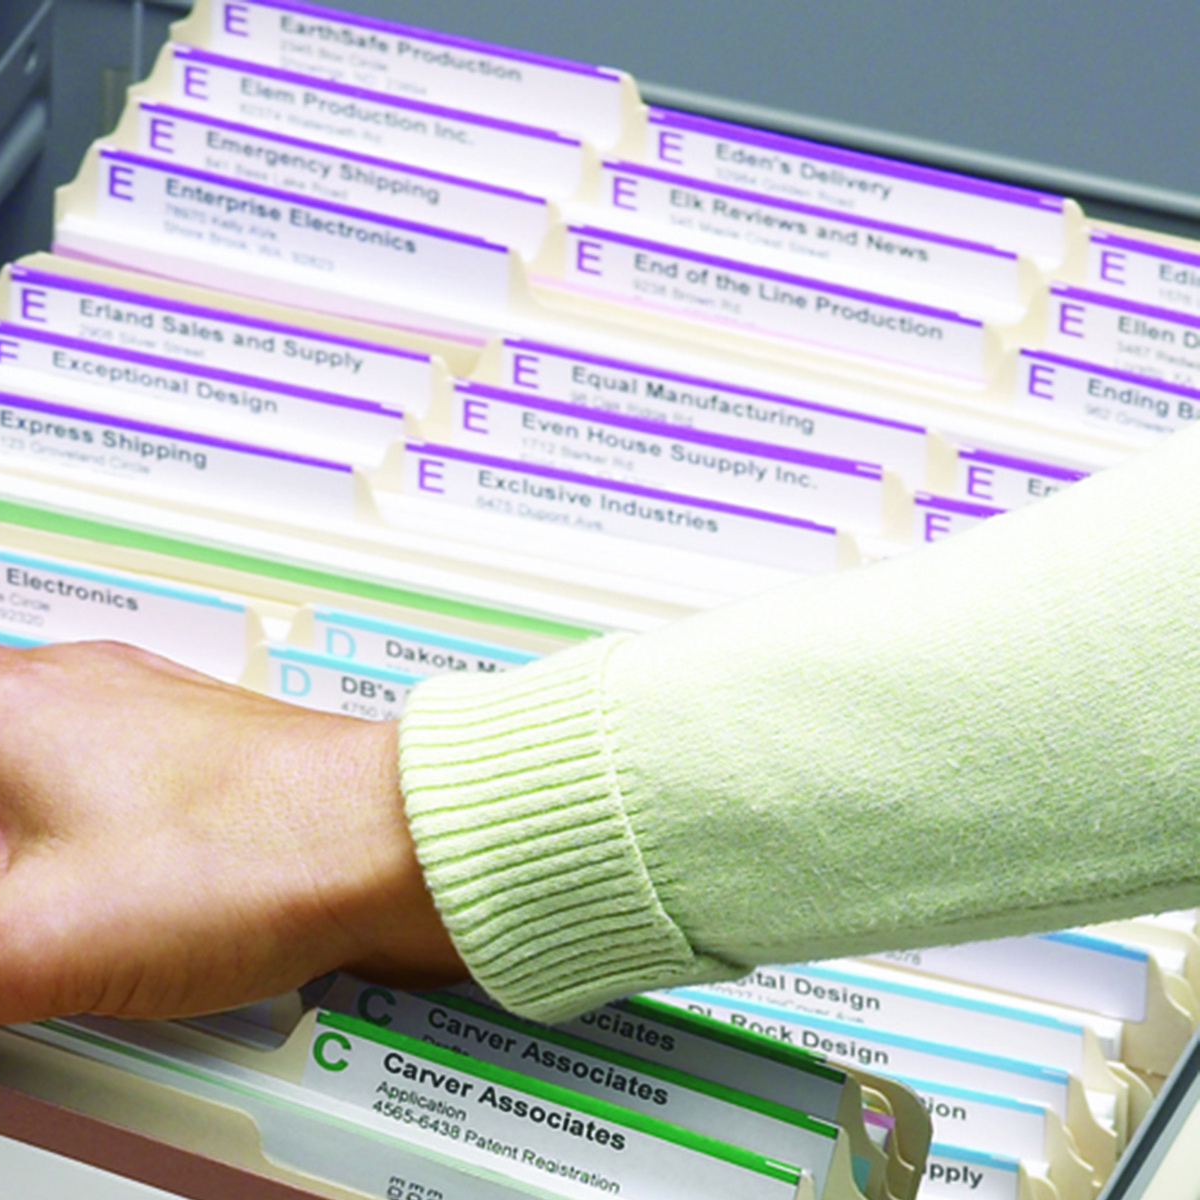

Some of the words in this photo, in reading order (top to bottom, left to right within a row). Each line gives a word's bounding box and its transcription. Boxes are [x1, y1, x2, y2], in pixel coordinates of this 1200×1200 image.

[223, 4, 249, 37] E
[280, 16, 388, 53] EarthSafe
[397, 41, 521, 82] Production
[241, 77, 294, 103] Elem
[304, 93, 426, 134] Production
[434, 124, 473, 145] Inc.
[206, 131, 332, 177] Emergency
[340, 164, 440, 205] Shipping
[715, 143, 790, 175] Eden's
[800, 162, 891, 200] Delivery
[165, 178, 281, 221] Enterprise
[290, 209, 416, 253] Electronics
[670, 188, 701, 209] Elk
[712, 197, 806, 235] Reviews
[817, 221, 858, 246] and
[867, 234, 928, 263] News
[634, 253, 678, 279] End
[687, 267, 709, 285] of
[716, 274, 750, 297] the
[759, 282, 806, 308] Line
[816, 296, 943, 341] Production
[80, 299, 154, 328] Erland
[162, 316, 223, 345] Sales
[233, 332, 274, 352] and
[284, 339, 363, 373] Supply
[1119, 315, 1174, 343] Ellen
[53, 351, 188, 394] Exceptional
[197, 383, 277, 413] Design
[572, 366, 638, 395] Equal
[645, 381, 814, 436] Manufacturing
[1088, 379, 1169, 419] Ending
[0, 410, 94, 444] Express
[102, 430, 207, 470] Shipping
[522, 412, 579, 440] Even
[587, 427, 662, 457] House
[671, 444, 767, 483] Suupply
[776, 463, 817, 490] Inc.
[479, 470, 592, 508] Exclusive
[600, 494, 718, 533] Industries
[7, 568, 139, 611] Electronics
[386, 640, 467, 671] Dakota
[341, 677, 396, 702] DB's
[795, 978, 880, 1011] Design
[428, 1009, 516, 1053] Carver
[522, 1042, 669, 1106] Associates
[802, 1031, 889, 1065] Design
[376, 1081, 467, 1122] Application
[384, 1053, 473, 1098] Carver
[480, 1086, 626, 1151] Associates
[373, 1099, 460, 1141] 4565-6438
[465, 1129, 517, 1162] Patent
[523, 1148, 620, 1194] Registration
